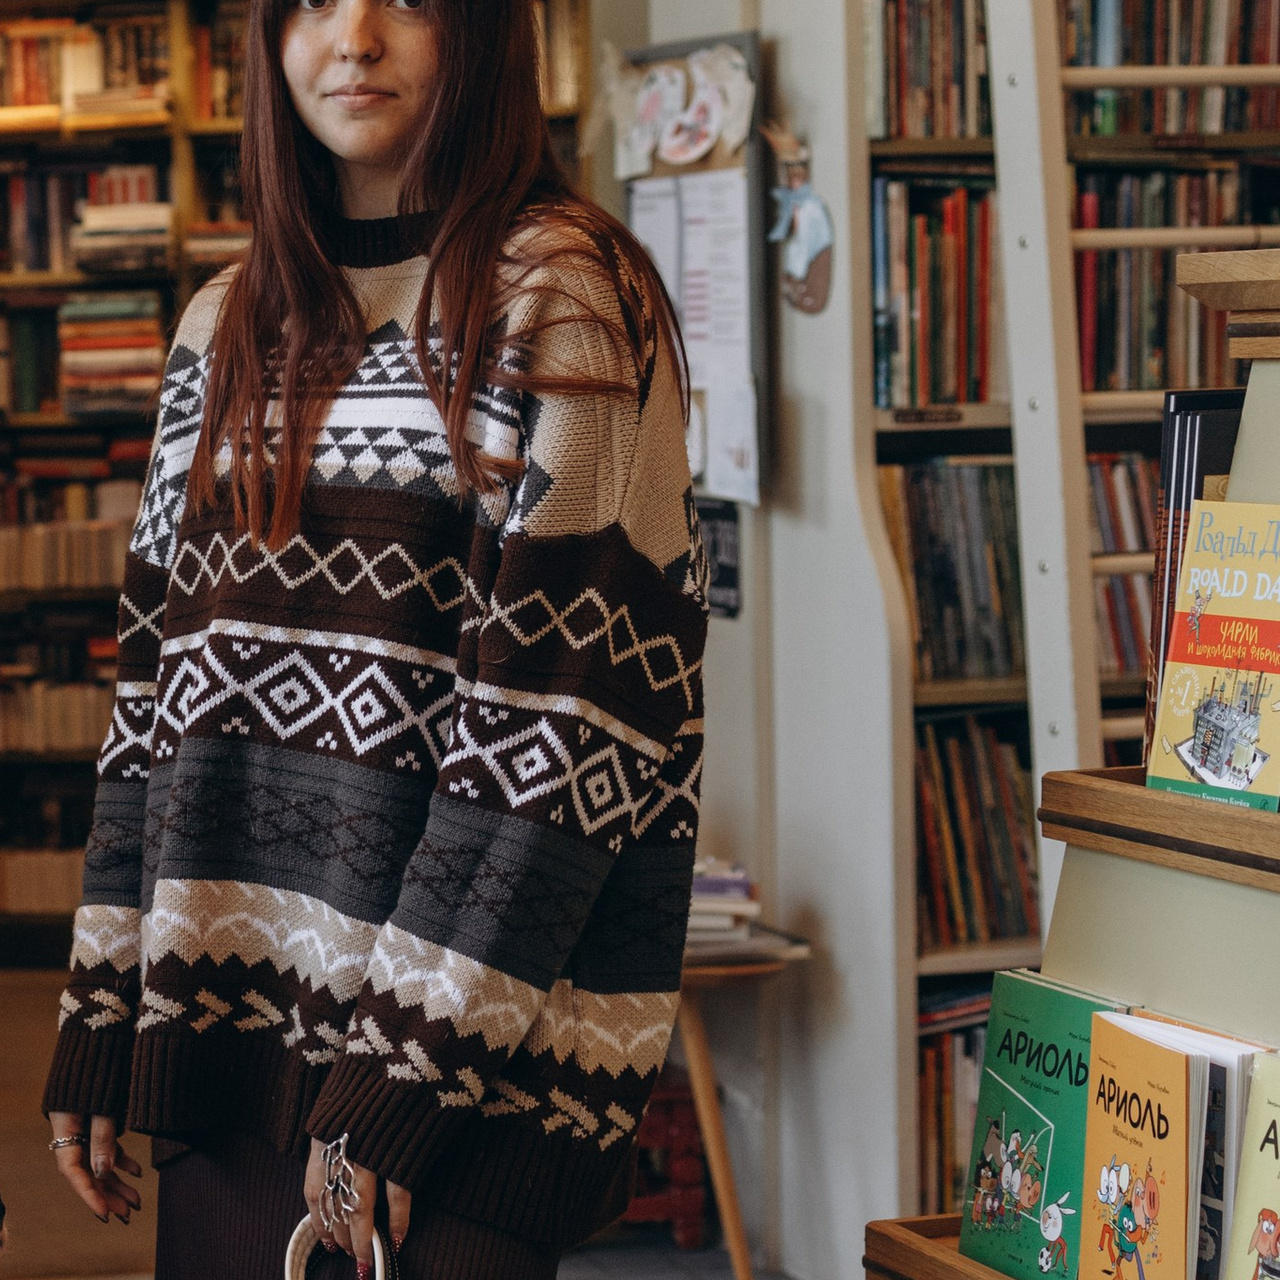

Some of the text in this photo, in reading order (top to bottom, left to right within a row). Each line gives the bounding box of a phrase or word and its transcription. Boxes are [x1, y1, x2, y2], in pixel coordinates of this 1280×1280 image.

[1193, 511, 1258, 562] Роальд
[1186, 567, 1249, 598] ROALD
[1187, 642, 1194, 655] И
[1195, 642, 1247, 661] ШОКОЛАДНАЯ
[1220, 621, 1260, 645] ЧАРЛИ
[996, 1028, 1090, 1087] АРИОЛЬ
[1095, 1074, 1170, 1140] АРИОЛЬ
